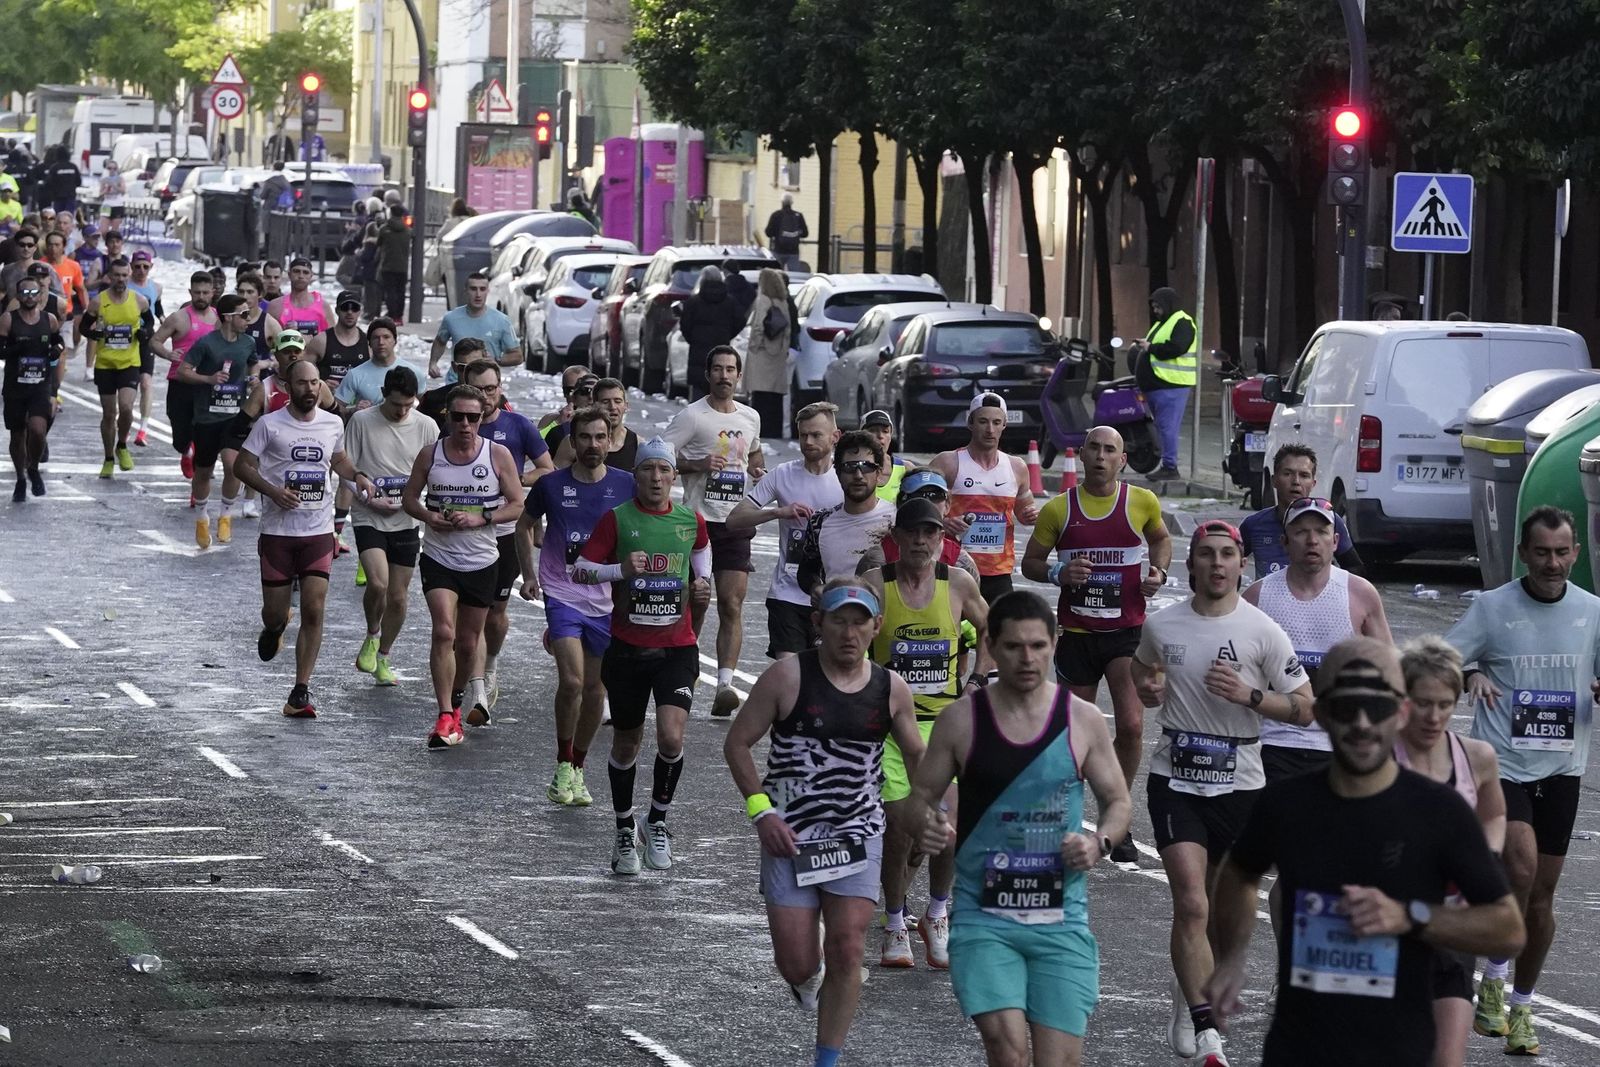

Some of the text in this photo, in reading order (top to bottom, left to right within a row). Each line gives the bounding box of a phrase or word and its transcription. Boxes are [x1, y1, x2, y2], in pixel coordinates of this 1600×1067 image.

[218, 97, 239, 108] 30
[215, 398, 237, 406] RAMÓN
[1406, 467, 1465, 480] 9177 MFY
[432, 484, 489, 494] Edinburgh AC
[706, 491, 721, 499] TONI
[454, 497, 479, 505] ZURICH
[970, 535, 999, 544] SMART
[1084, 596, 1106, 607] NEIL
[635, 603, 677, 614] MARCOS
[912, 643, 945, 651] ZURICH
[912, 659, 931, 667] 5256
[1536, 694, 1571, 703] ZURICH
[1537, 712, 1557, 720] 4398
[1524, 723, 1566, 737] ALEXIS
[1192, 737, 1230, 749] ZURICH
[1192, 755, 1212, 765] 4520
[1173, 766, 1234, 783] ALEXANDRE
[810, 850, 851, 869] DAVID
[1013, 857, 1055, 868] ZURICH
[1013, 879, 1038, 888] 5174
[998, 892, 1050, 907] OLIVER
[1306, 946, 1378, 972] MIGUEL
